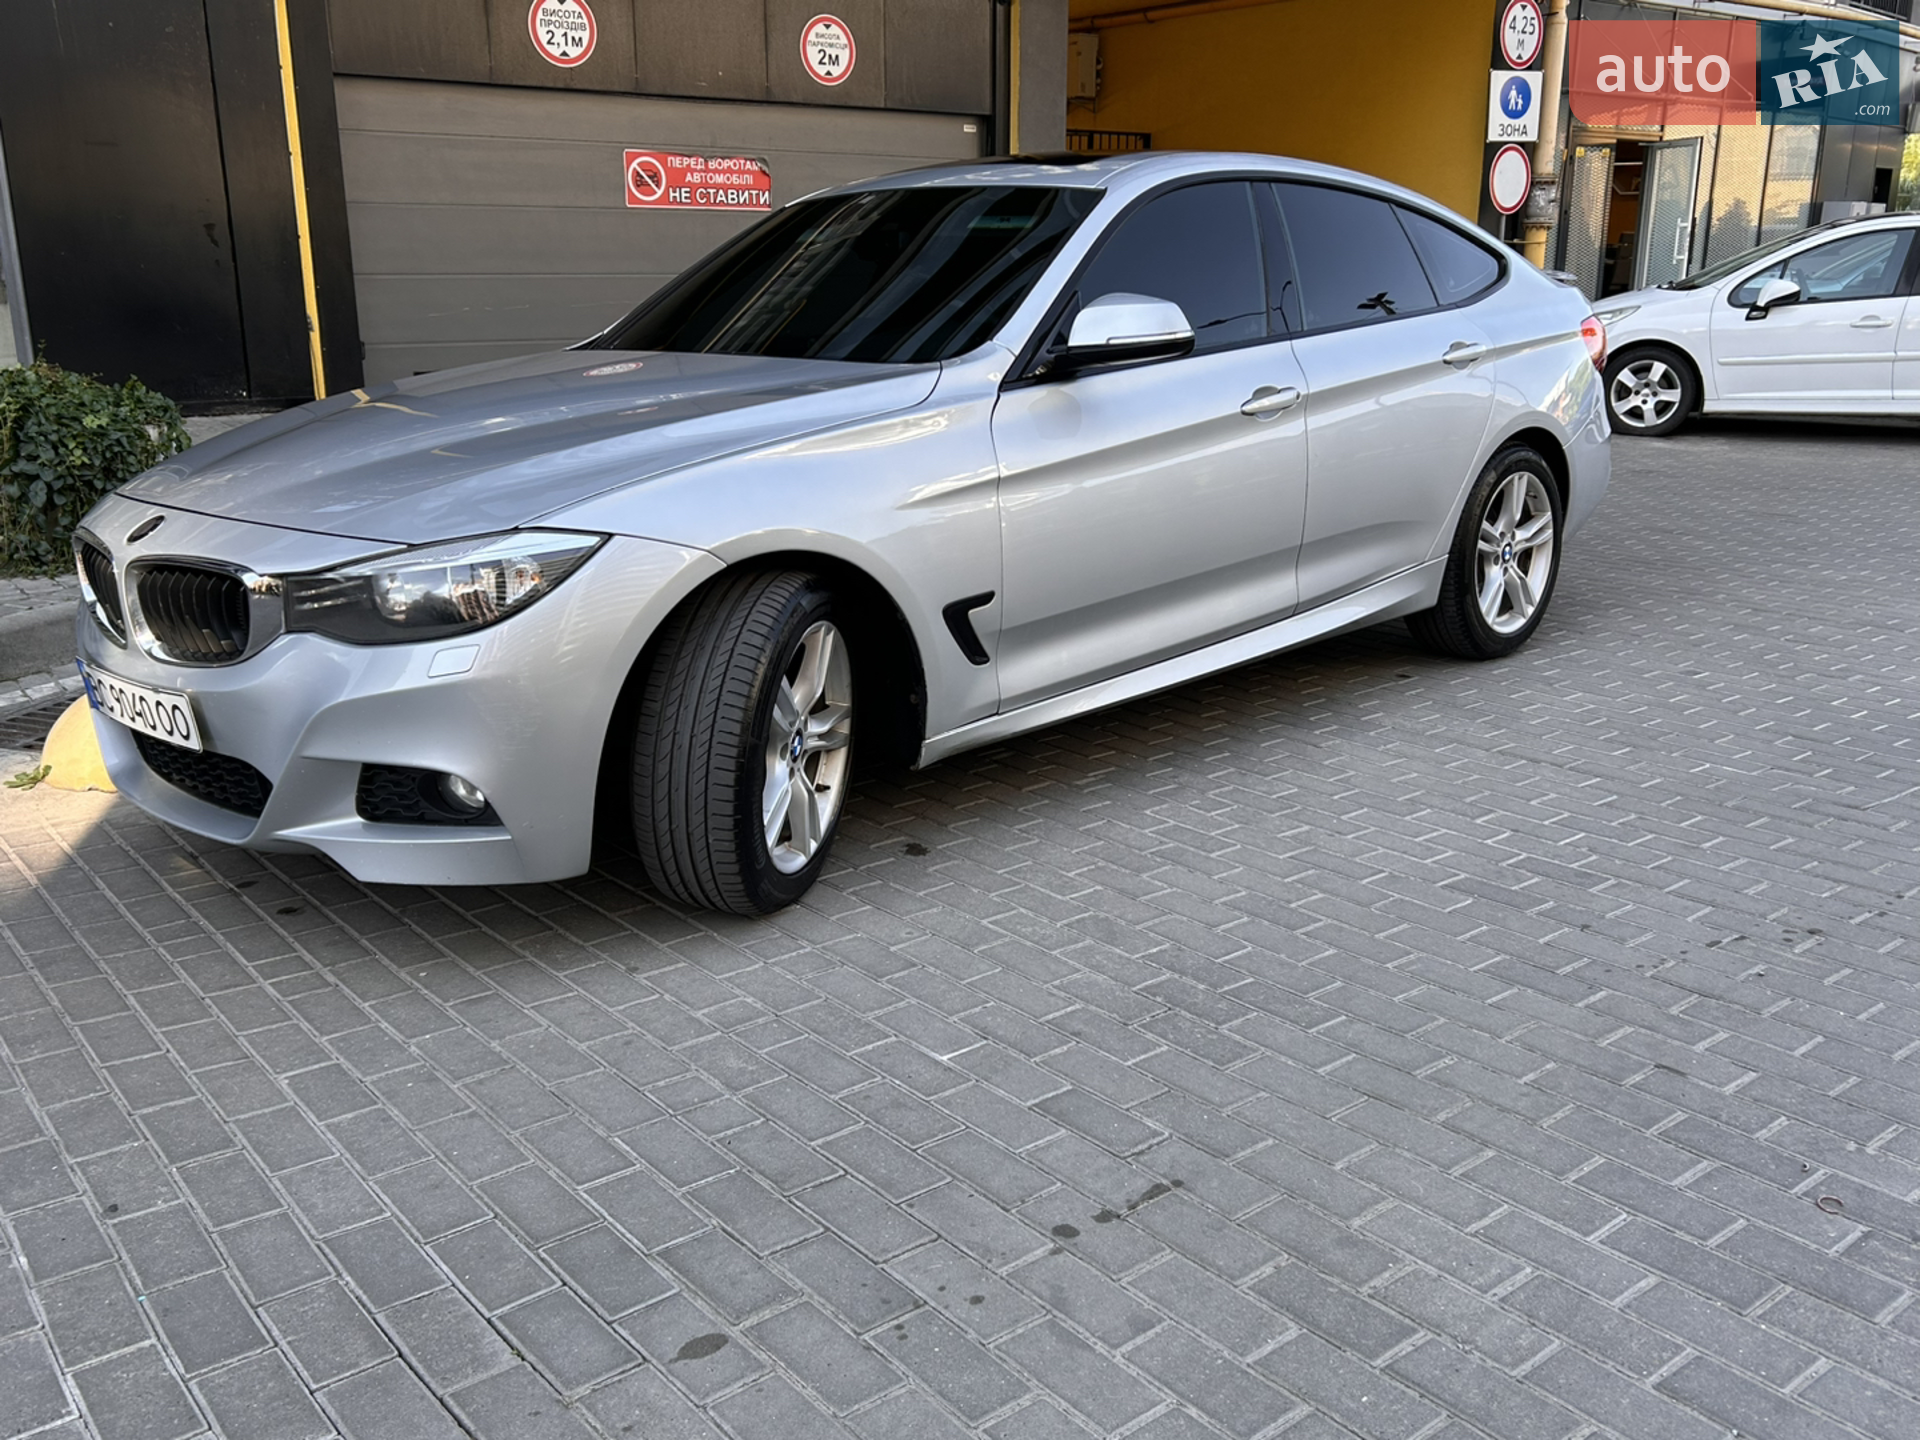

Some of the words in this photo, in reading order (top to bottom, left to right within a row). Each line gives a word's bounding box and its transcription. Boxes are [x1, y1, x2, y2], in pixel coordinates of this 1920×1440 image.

[542, 8, 584, 20] ВИСОТА
[539, 18, 587, 32] ПРОЇЗДІВ
[815, 32, 841, 41] ВИСОТА
[1498, 123, 1528, 137] ЗОНА
[667, 156, 705, 170] ПЕРЕД
[685, 172, 753, 185] АВТОМОБІЛІ
[669, 187, 691, 203] НЕ
[696, 188, 770, 205] СТАВИТИ
